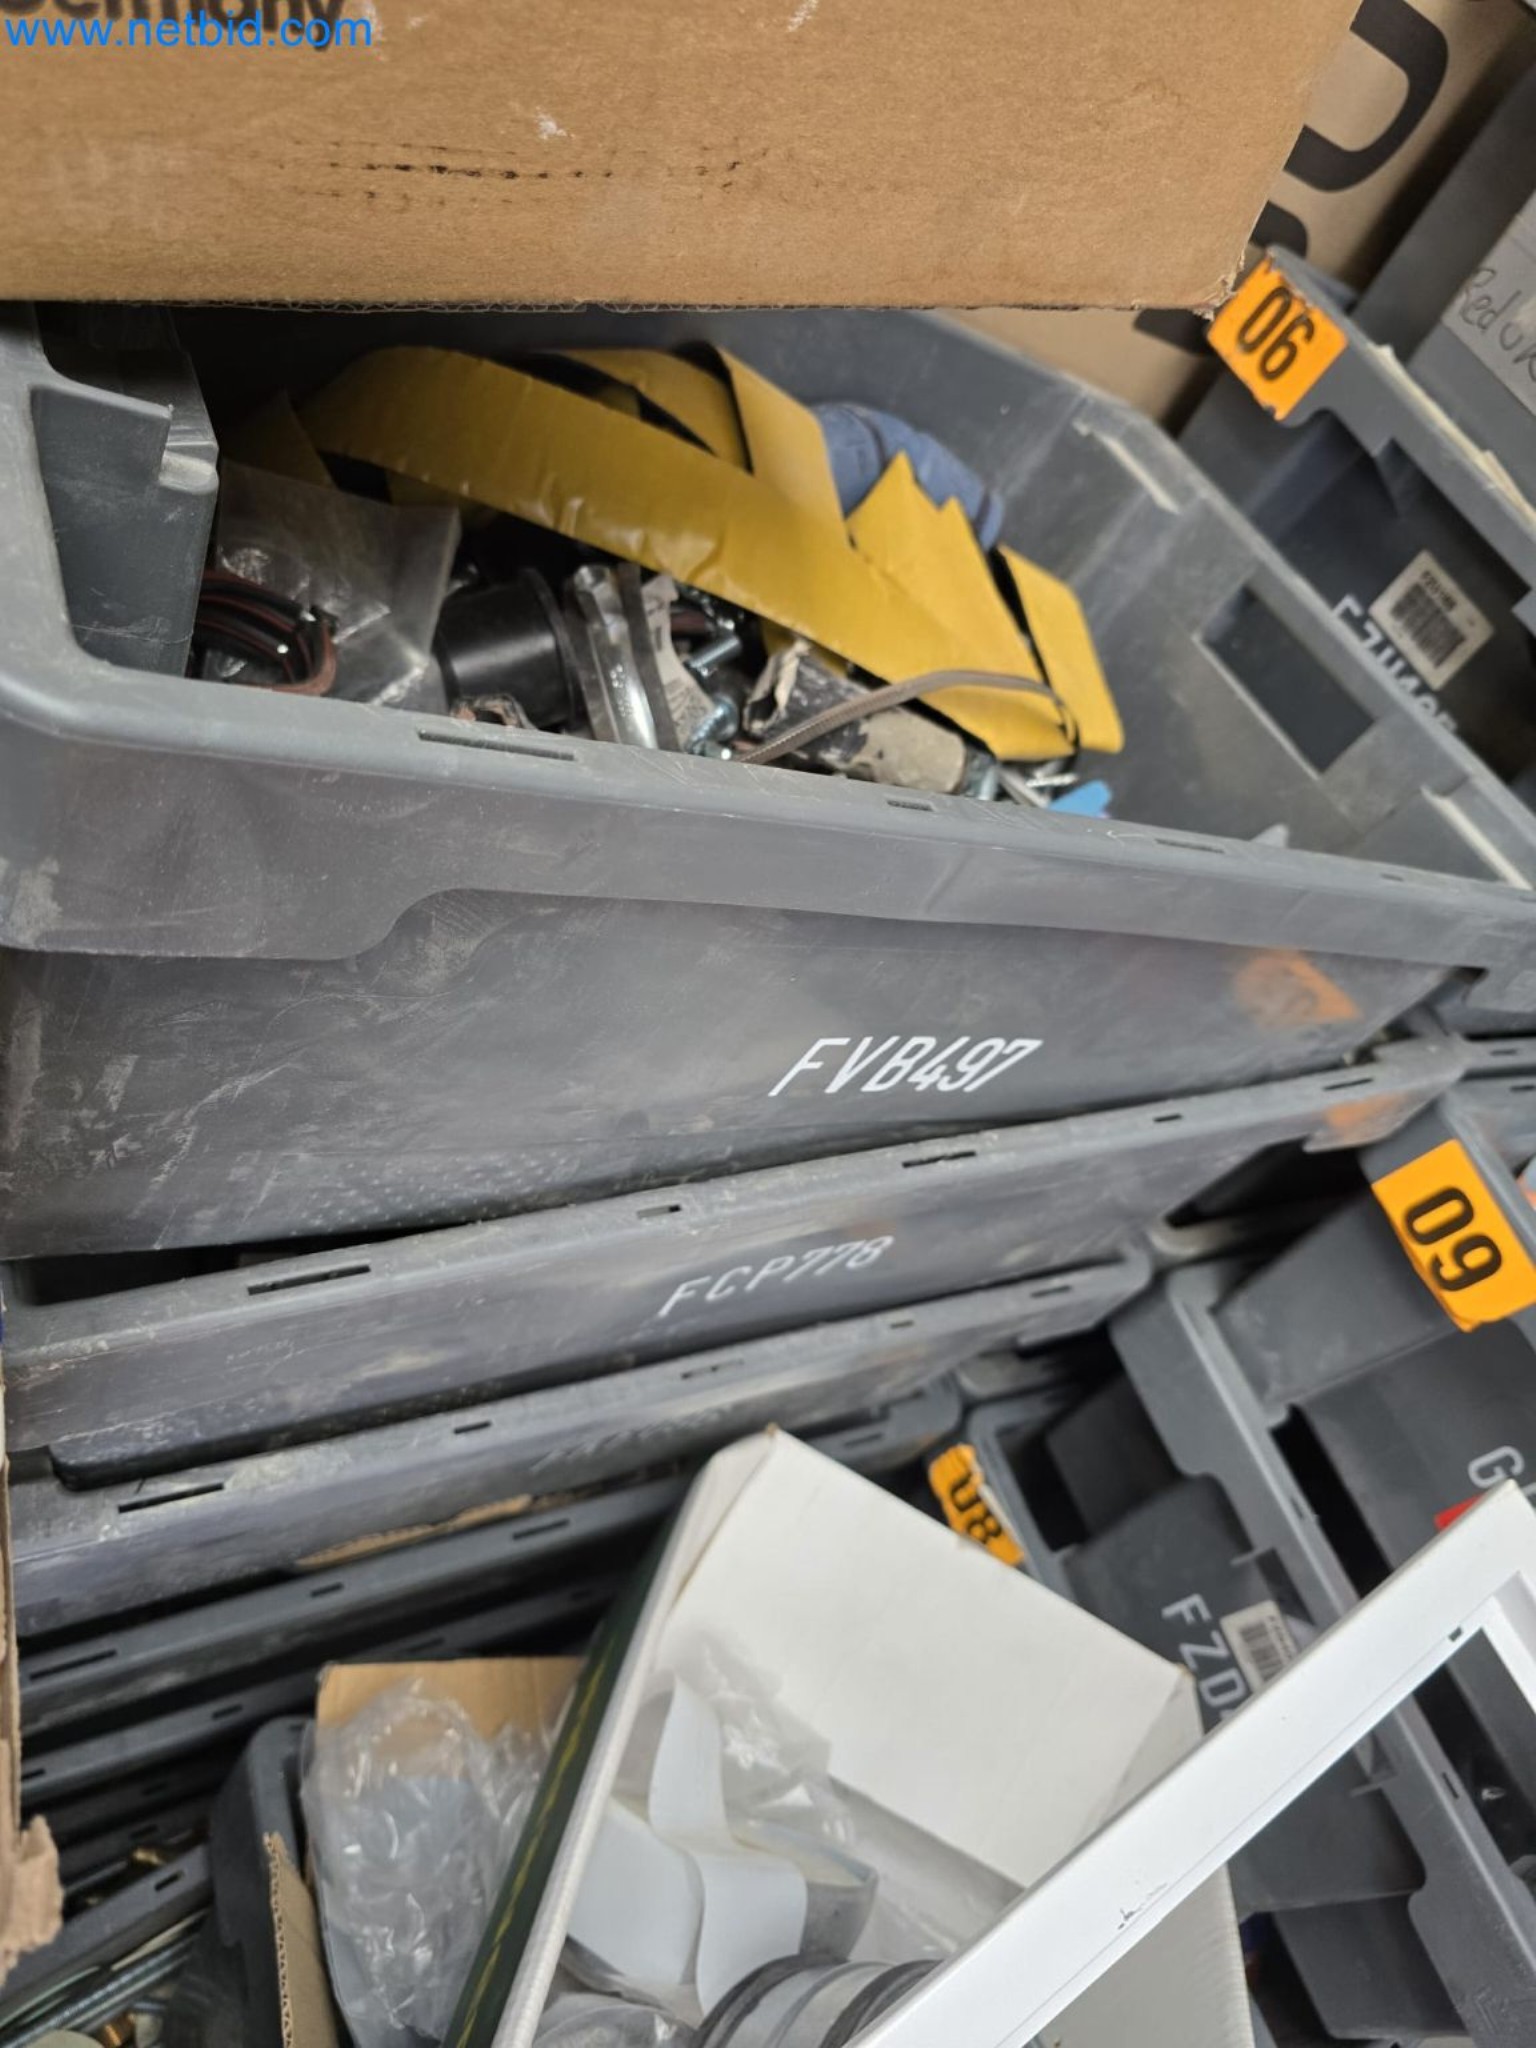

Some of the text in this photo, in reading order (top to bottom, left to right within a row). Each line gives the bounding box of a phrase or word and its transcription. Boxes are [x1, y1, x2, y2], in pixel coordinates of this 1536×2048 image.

[1236, 285, 1316, 382] 06
[768, 1035, 1044, 1097] FVB497
[657, 1234, 895, 1319] FCP778
[1405, 1186, 1503, 1293] 09
[1160, 1593, 1248, 1721] FZD
